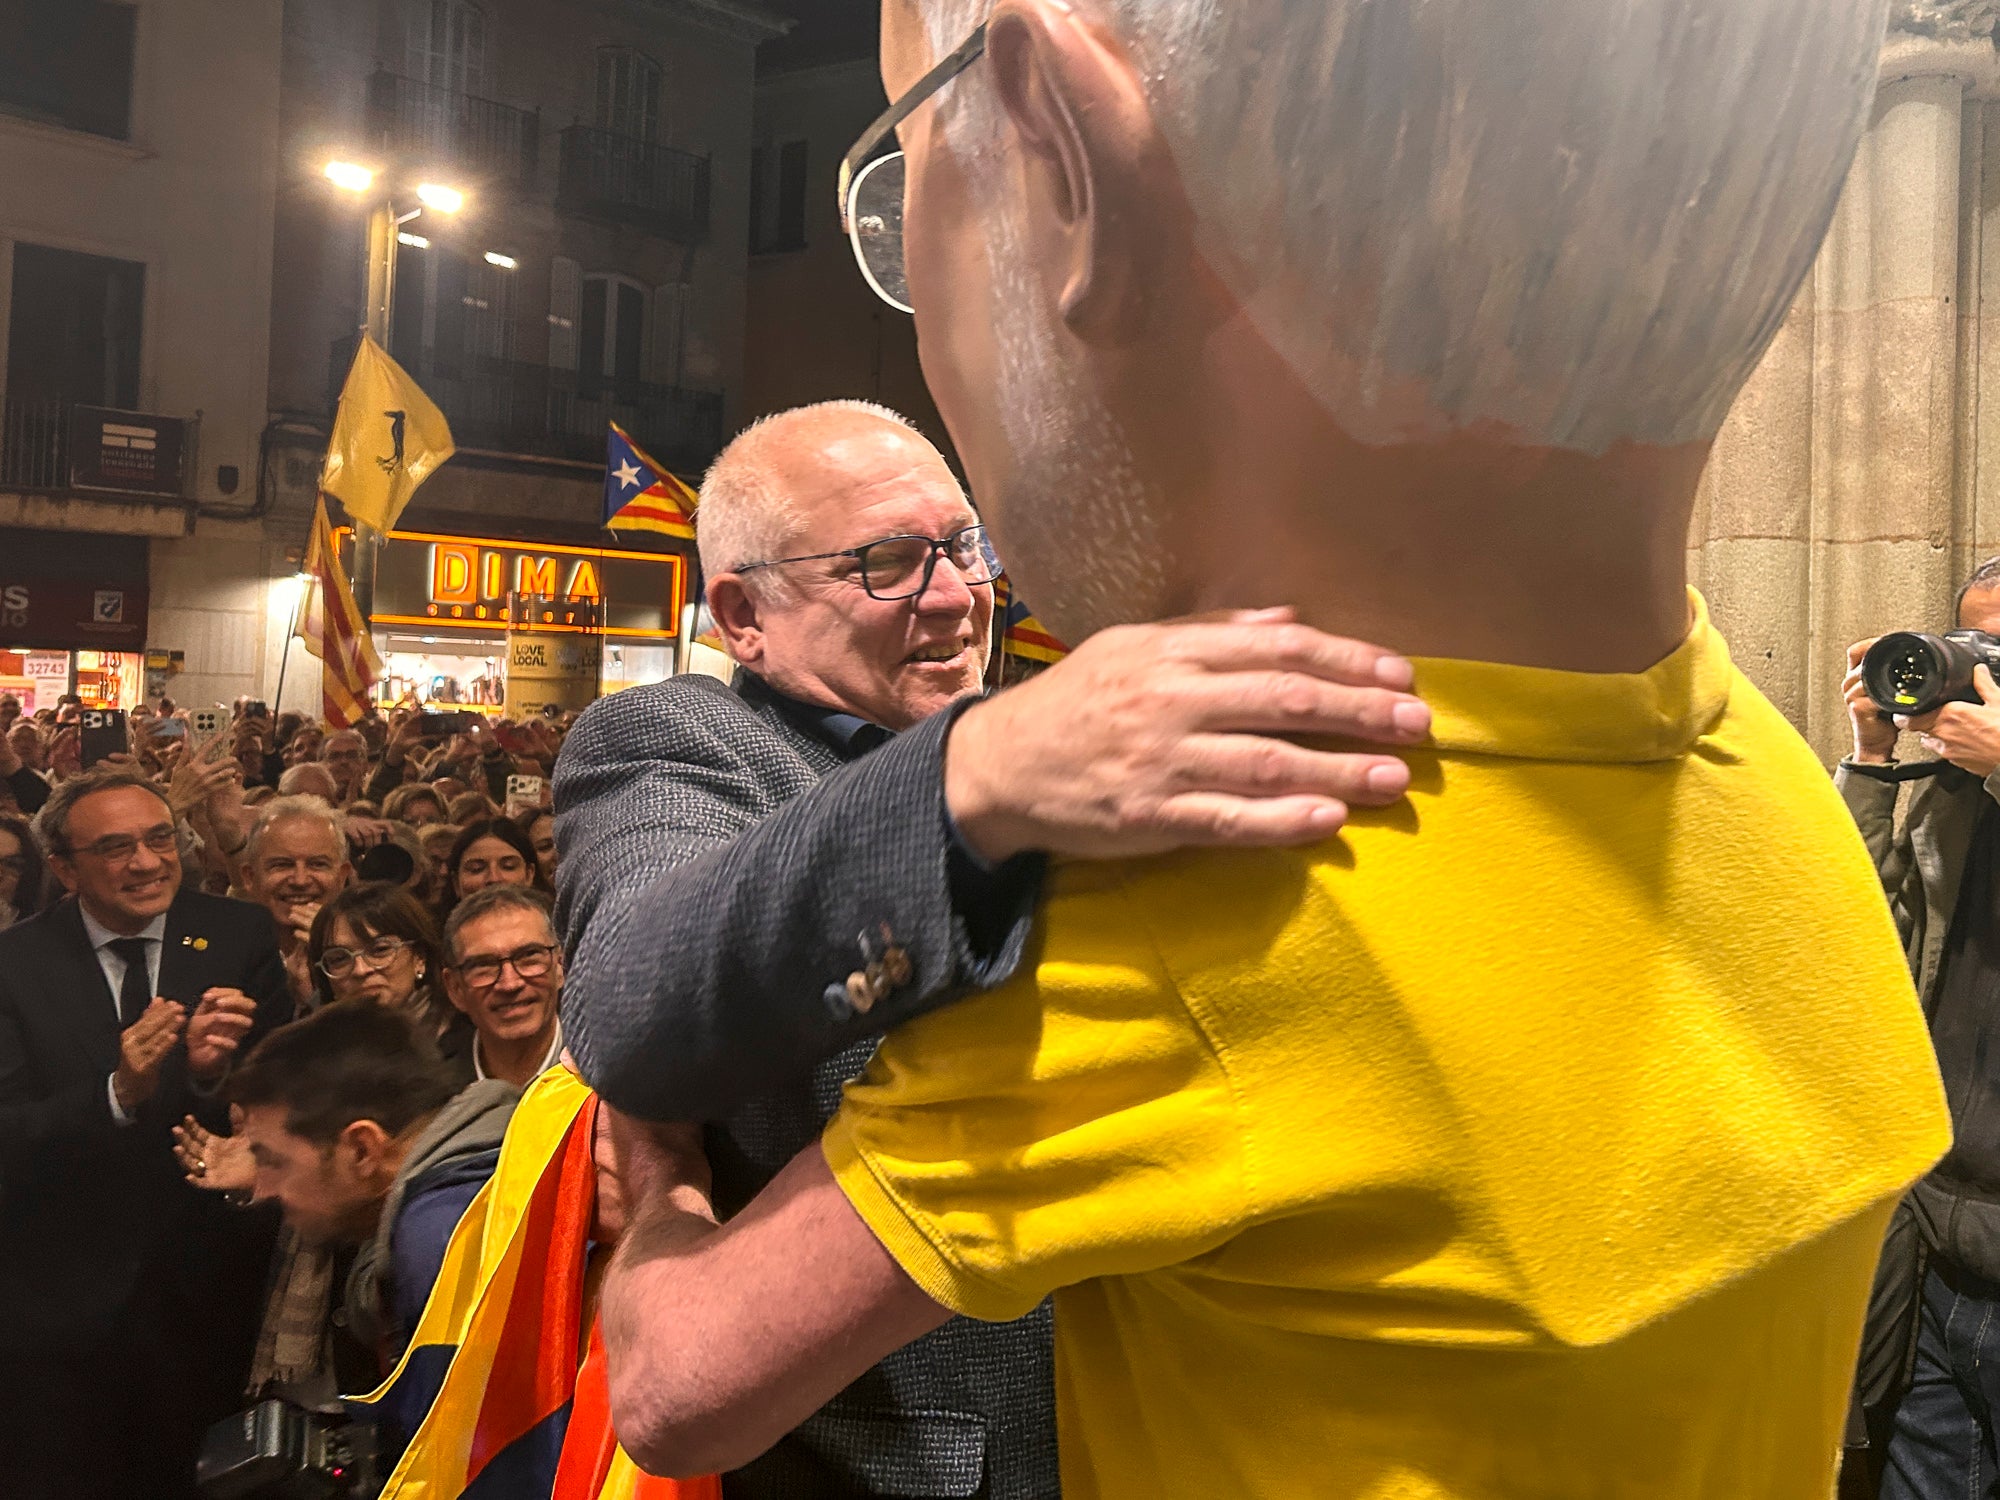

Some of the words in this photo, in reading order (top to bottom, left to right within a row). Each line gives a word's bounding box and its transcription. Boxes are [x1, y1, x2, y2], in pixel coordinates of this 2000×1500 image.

[431, 544, 600, 606] DIMA
[516, 644, 545, 656] LOVE
[513, 655, 548, 667] LOCAL
[27, 663, 65, 675] 32743
